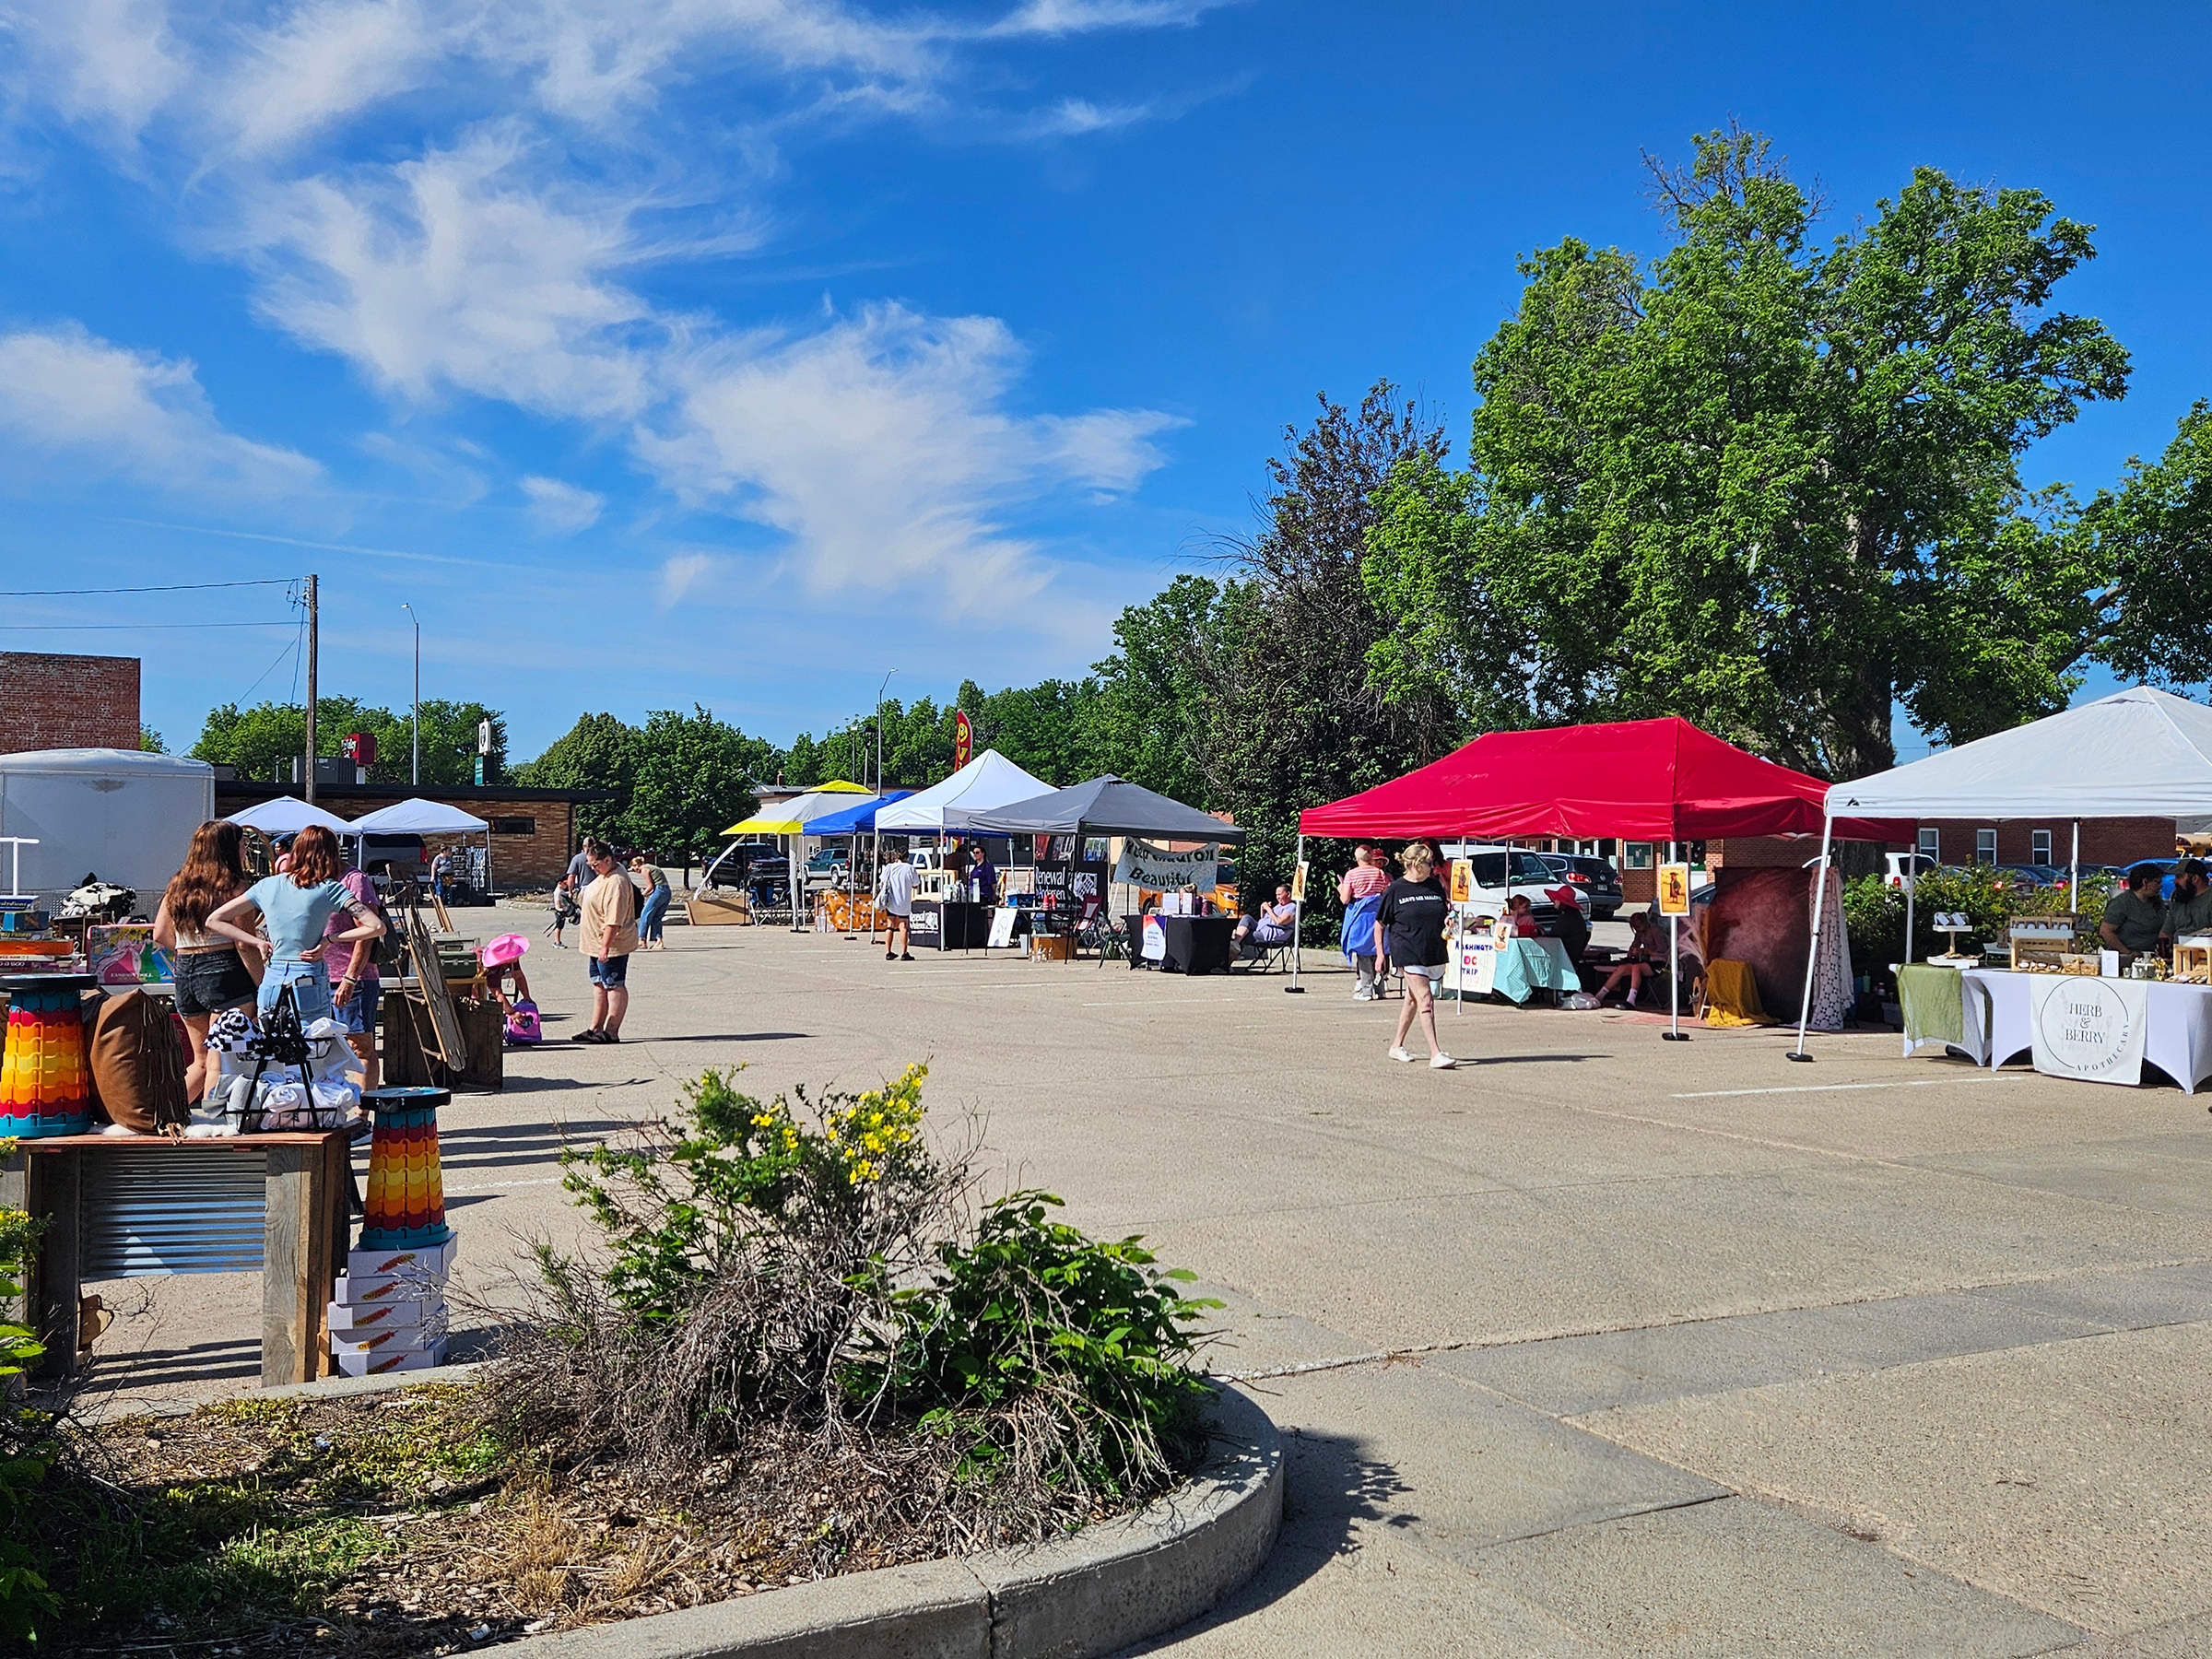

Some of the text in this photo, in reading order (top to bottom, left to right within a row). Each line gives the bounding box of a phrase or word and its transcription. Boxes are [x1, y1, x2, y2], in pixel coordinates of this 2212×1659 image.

[1464, 955, 1477, 966] DC
[2069, 1002, 2102, 1018] HERB
[2079, 1017, 2091, 1029] &
[2065, 1029, 2106, 1044] BERRY
[2076, 1024, 2129, 1072] APOTHECARY
